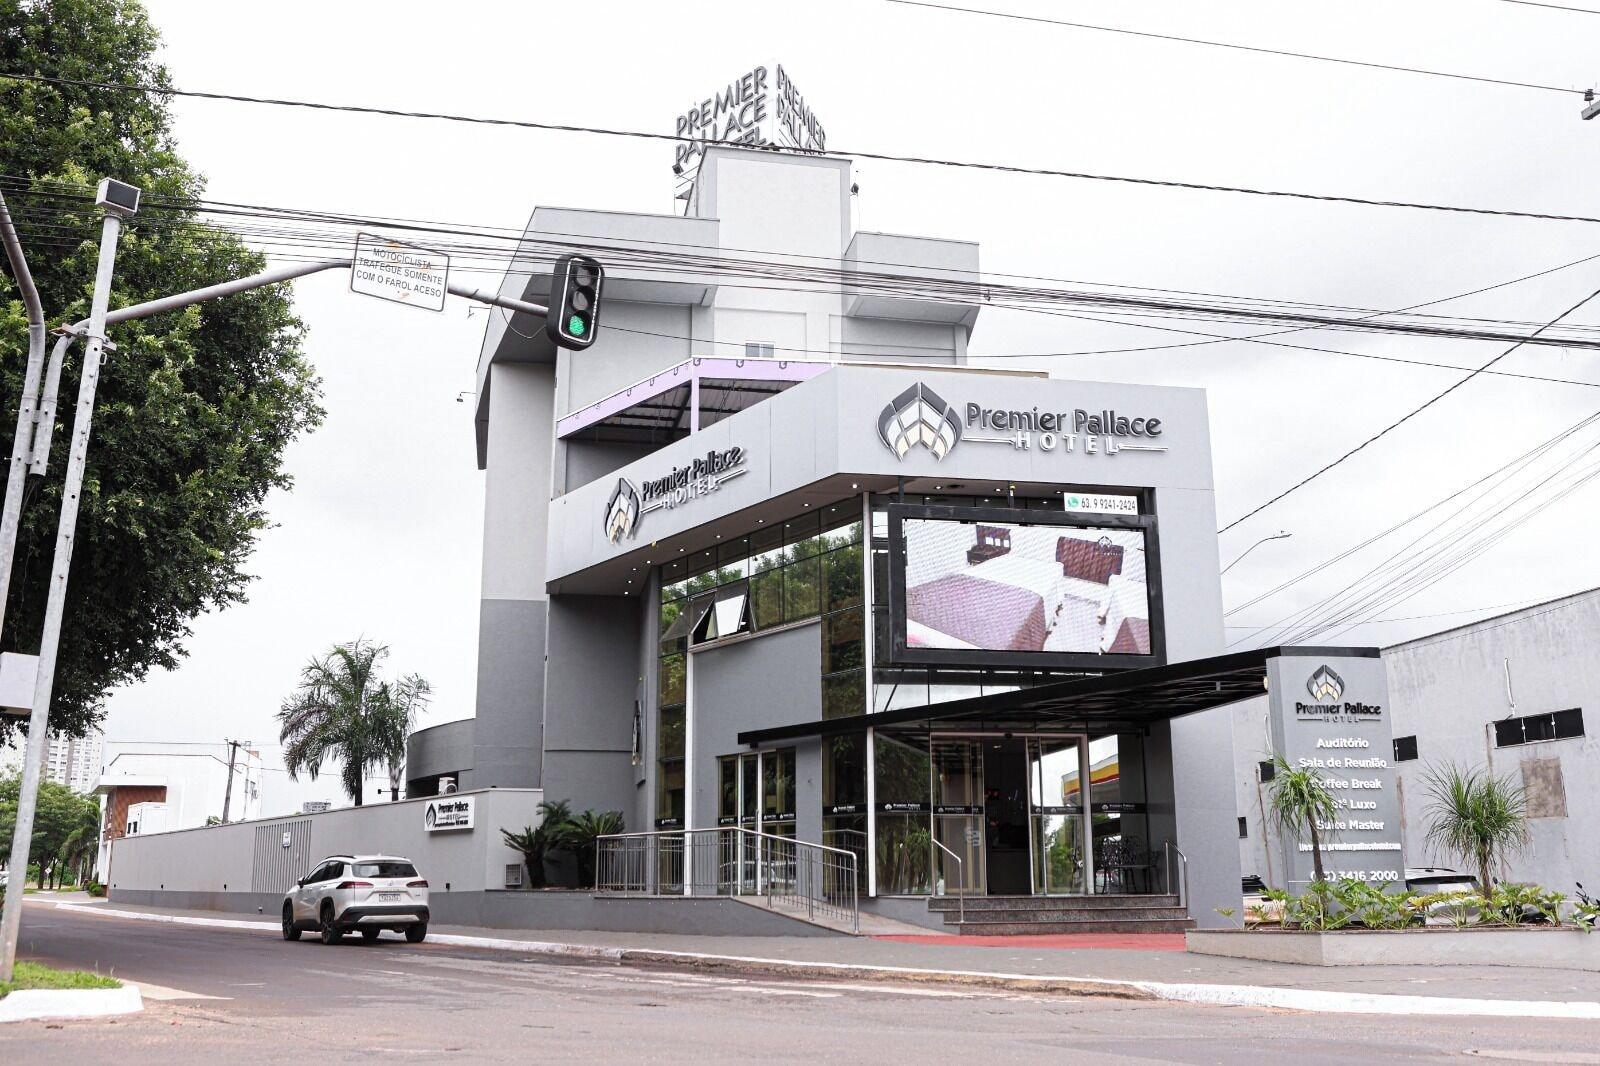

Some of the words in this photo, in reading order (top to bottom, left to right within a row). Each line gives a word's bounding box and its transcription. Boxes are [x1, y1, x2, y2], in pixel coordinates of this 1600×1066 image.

[676, 66, 768, 137] PREMIER
[777, 63, 826, 152] PREMIER
[373, 248, 432, 269] MOTOCICLISTA
[359, 257, 402, 276] TRAFEGUE
[404, 269, 443, 285] SOMENTE
[356, 270, 375, 281] COM
[377, 275, 384, 283] O
[385, 277, 412, 291] FAROL
[413, 285, 442, 298] ACESO
[966, 402, 1067, 432] Premier
[1073, 409, 1163, 437] Pallace
[1014, 432, 1120, 456] HOTEL
[642, 466, 693, 502] Premier
[693, 447, 745, 479] Pallace
[662, 475, 718, 509] HOTEL
[1094, 498, 1098, 508] 9
[1099, 499, 1136, 511] 9241-2424
[1296, 702, 1342, 715] Premier
[1344, 702, 1382, 715] Pallace
[1324, 715, 1359, 723] HOTEL
[1316, 737, 1370, 749] Auditório
[1299, 757, 1325, 767] Sala
[1326, 757, 1342, 767] de
[1344, 757, 1387, 768] Reunião
[1351, 778, 1383, 789] Break
[1350, 800, 1377, 810] Luxo
[1349, 820, 1385, 830] Master
[1310, 870, 1337, 882] (3)
[1338, 870, 1367, 881] 3416
[1369, 870, 1399, 881] 2000
